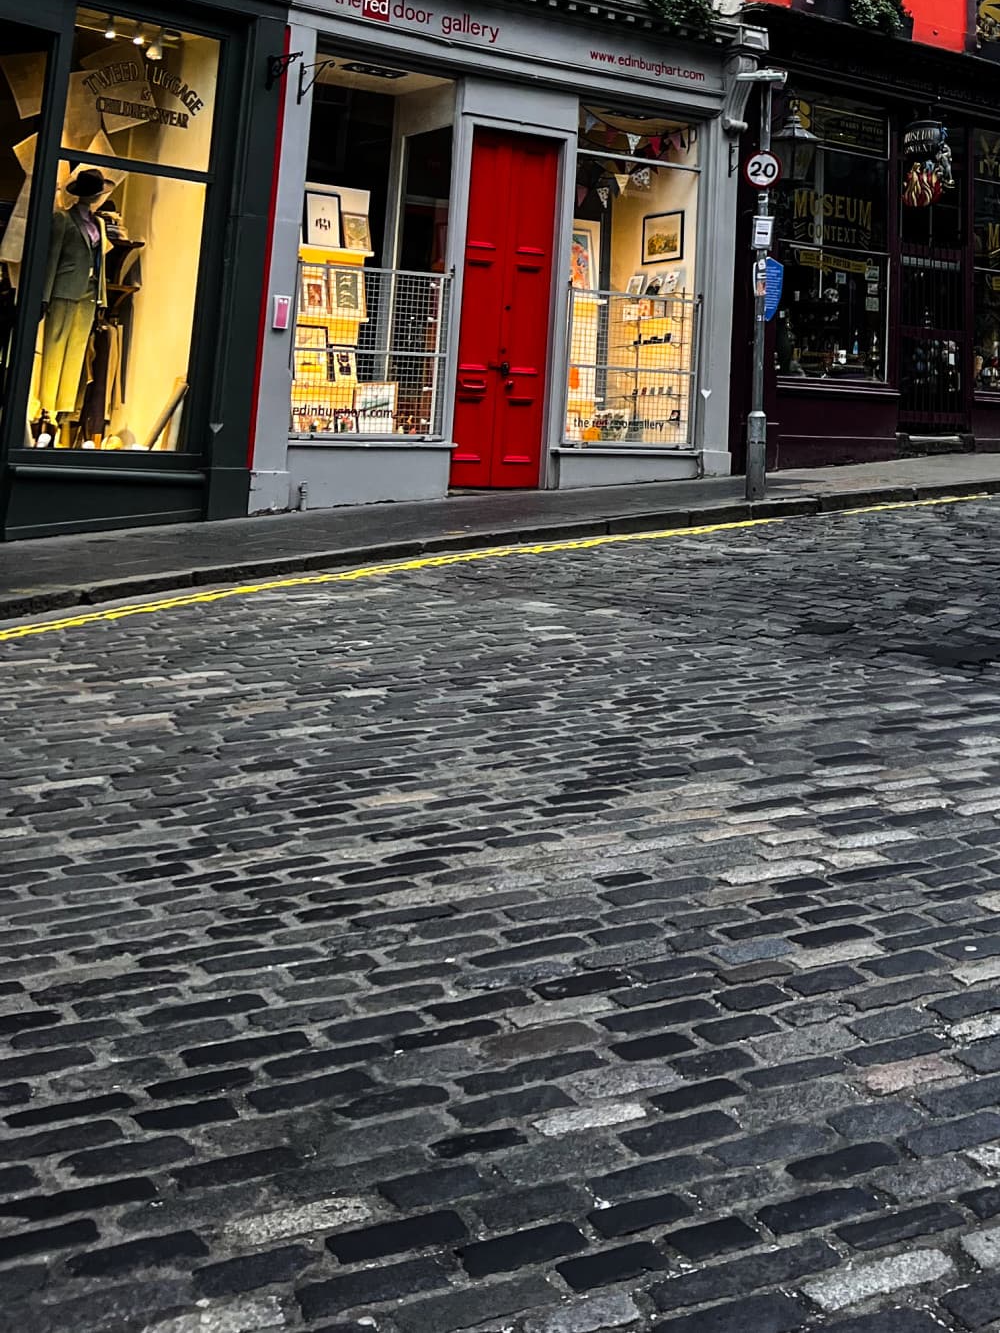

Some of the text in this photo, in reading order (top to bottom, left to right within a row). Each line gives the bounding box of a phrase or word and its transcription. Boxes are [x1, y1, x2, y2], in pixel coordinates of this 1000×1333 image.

[441, 13, 500, 44] gallery
[82, 61, 204, 116] TWEED LUGGAGE
[750, 161, 777, 179] 20
[793, 188, 873, 232] MUSEUM
[808, 221, 857, 244] CONTEXT
